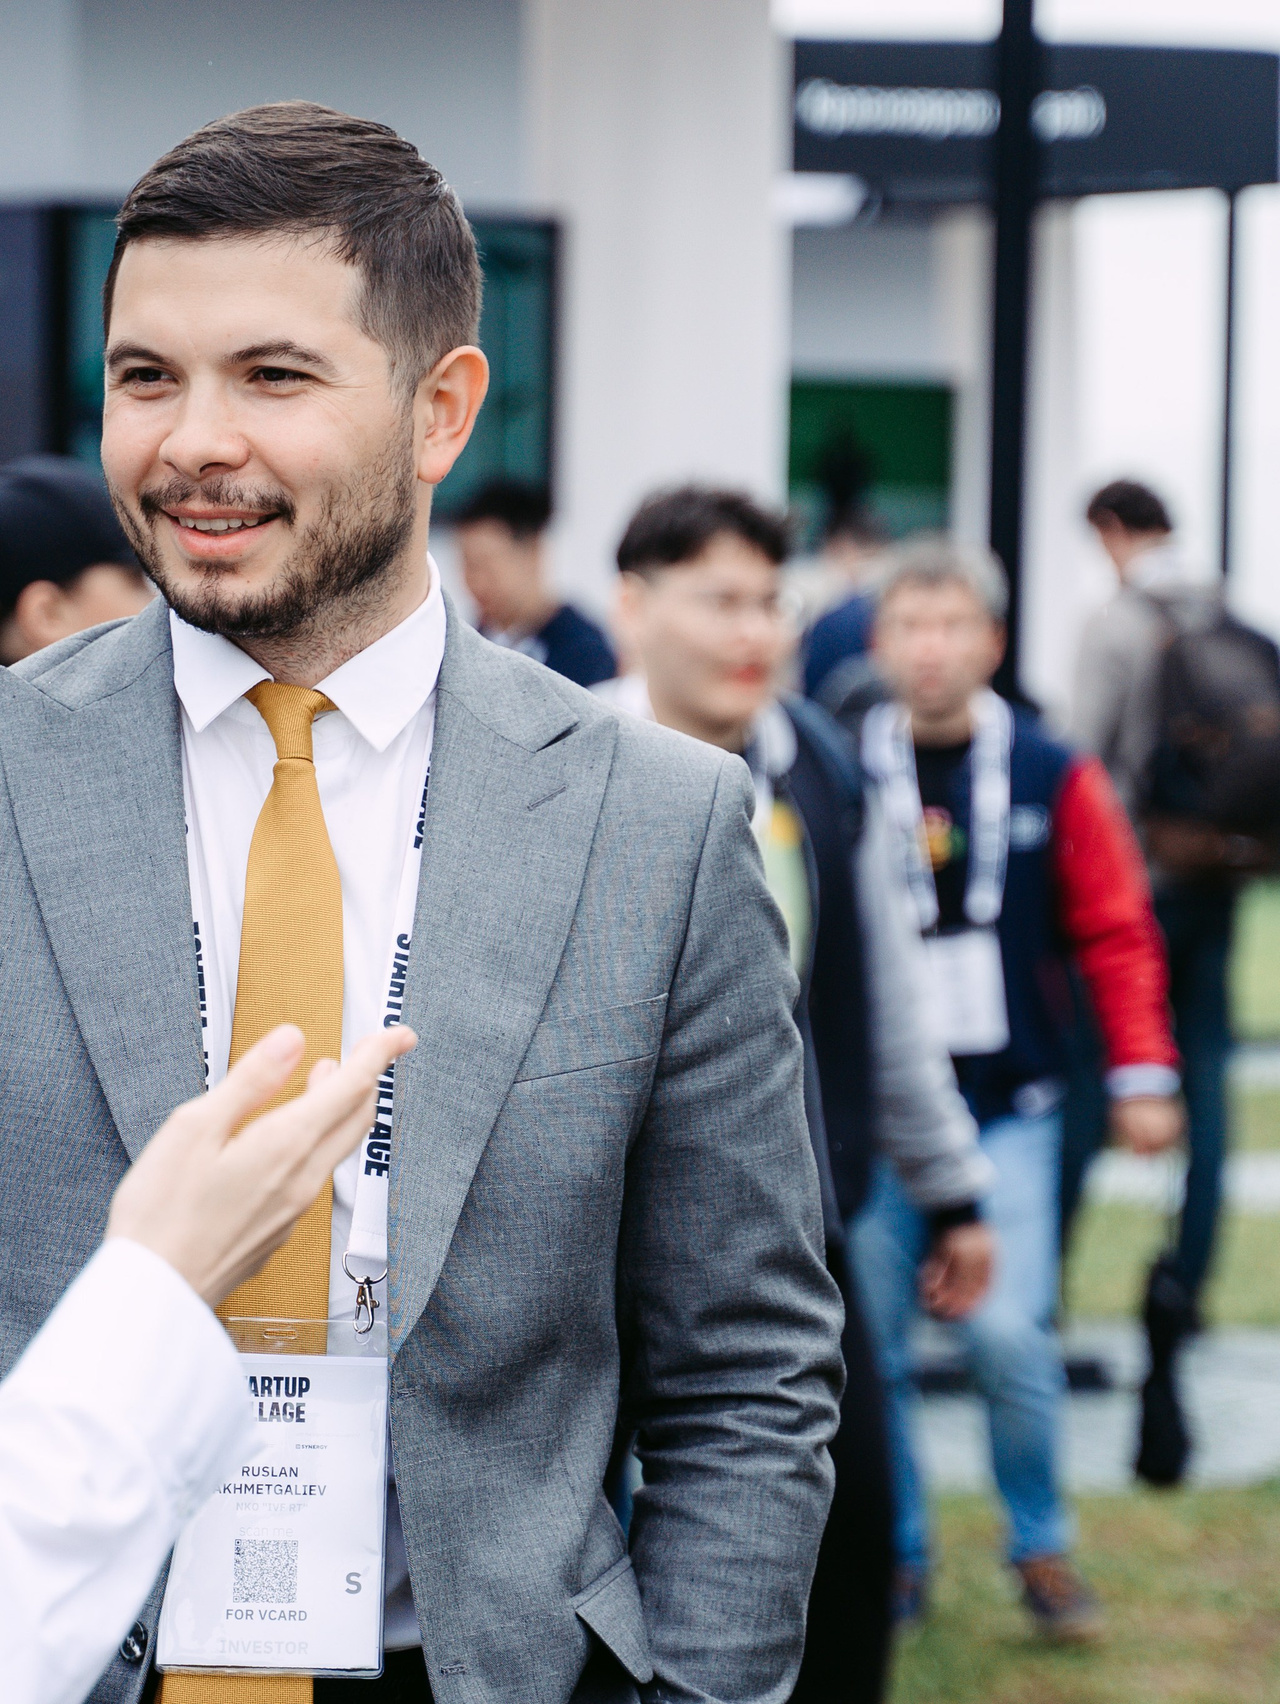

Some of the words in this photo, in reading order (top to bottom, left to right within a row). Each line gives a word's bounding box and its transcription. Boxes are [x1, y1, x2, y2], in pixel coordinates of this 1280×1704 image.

[245, 1375, 311, 1398] ARTUP
[252, 1401, 306, 1423] LAGE
[241, 1465, 299, 1478] RUSLAN
[236, 1502, 259, 1511] NKO
[239, 1526, 269, 1537] scan
[273, 1527, 294, 1538] me
[345, 1571, 363, 1595] S
[225, 1608, 254, 1620] FOR
[258, 1609, 308, 1621] VCARD
[219, 1639, 309, 1655] INVESTOR
